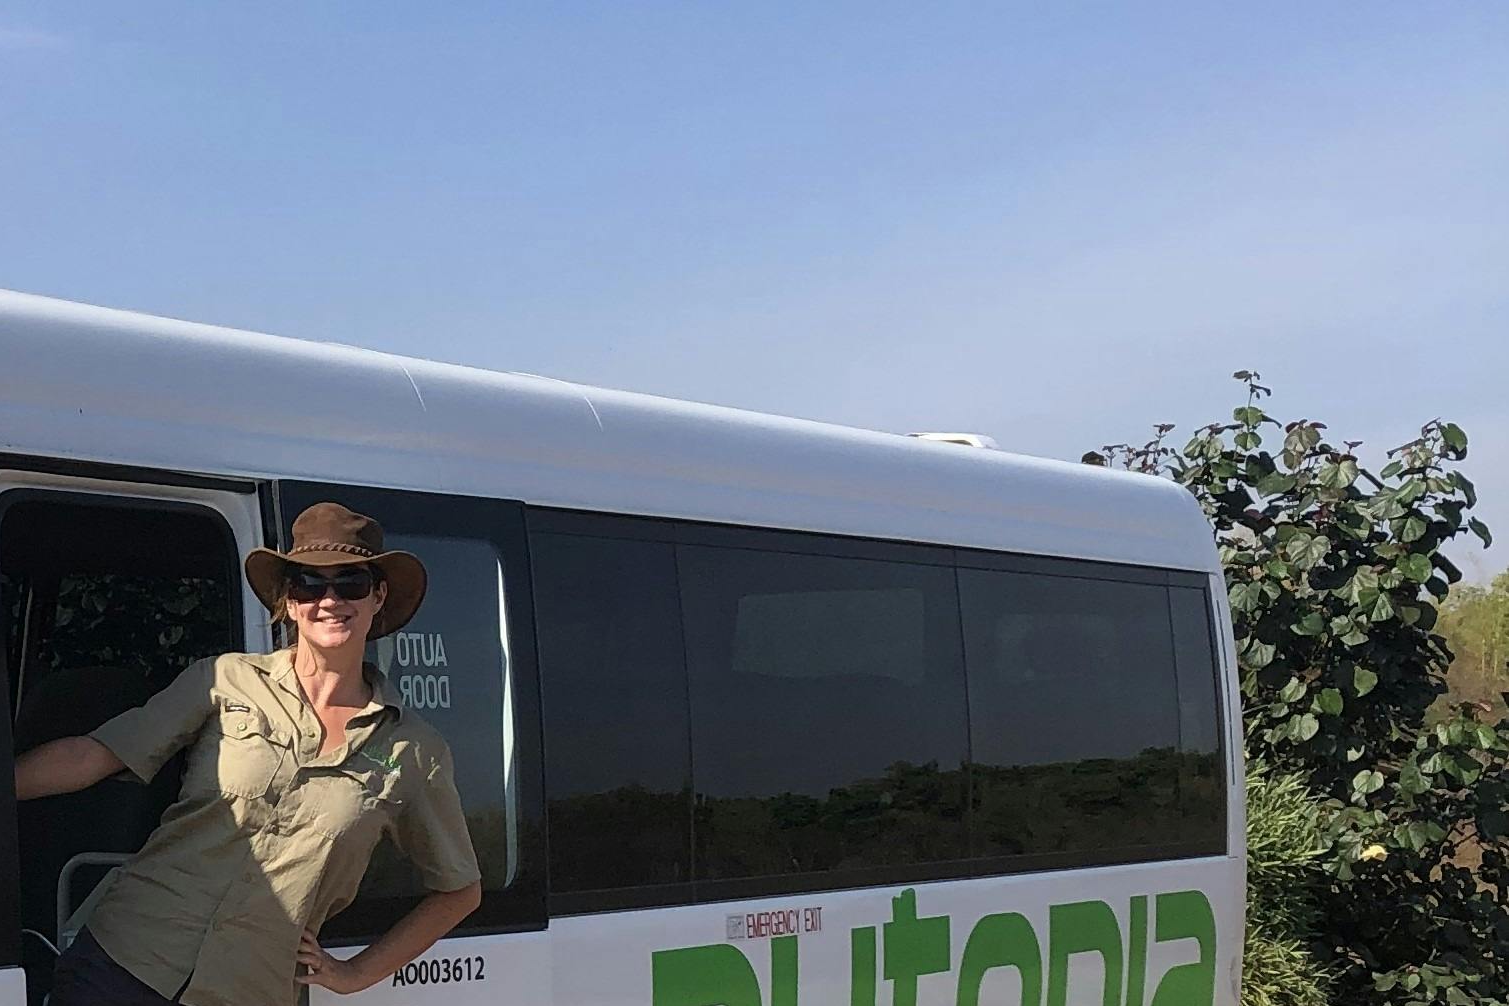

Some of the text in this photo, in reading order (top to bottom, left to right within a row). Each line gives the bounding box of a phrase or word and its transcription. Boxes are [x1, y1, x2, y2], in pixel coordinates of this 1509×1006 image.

[746, 906, 823, 939] EMERGENCY EXIT
[392, 956, 485, 988] AO003612
